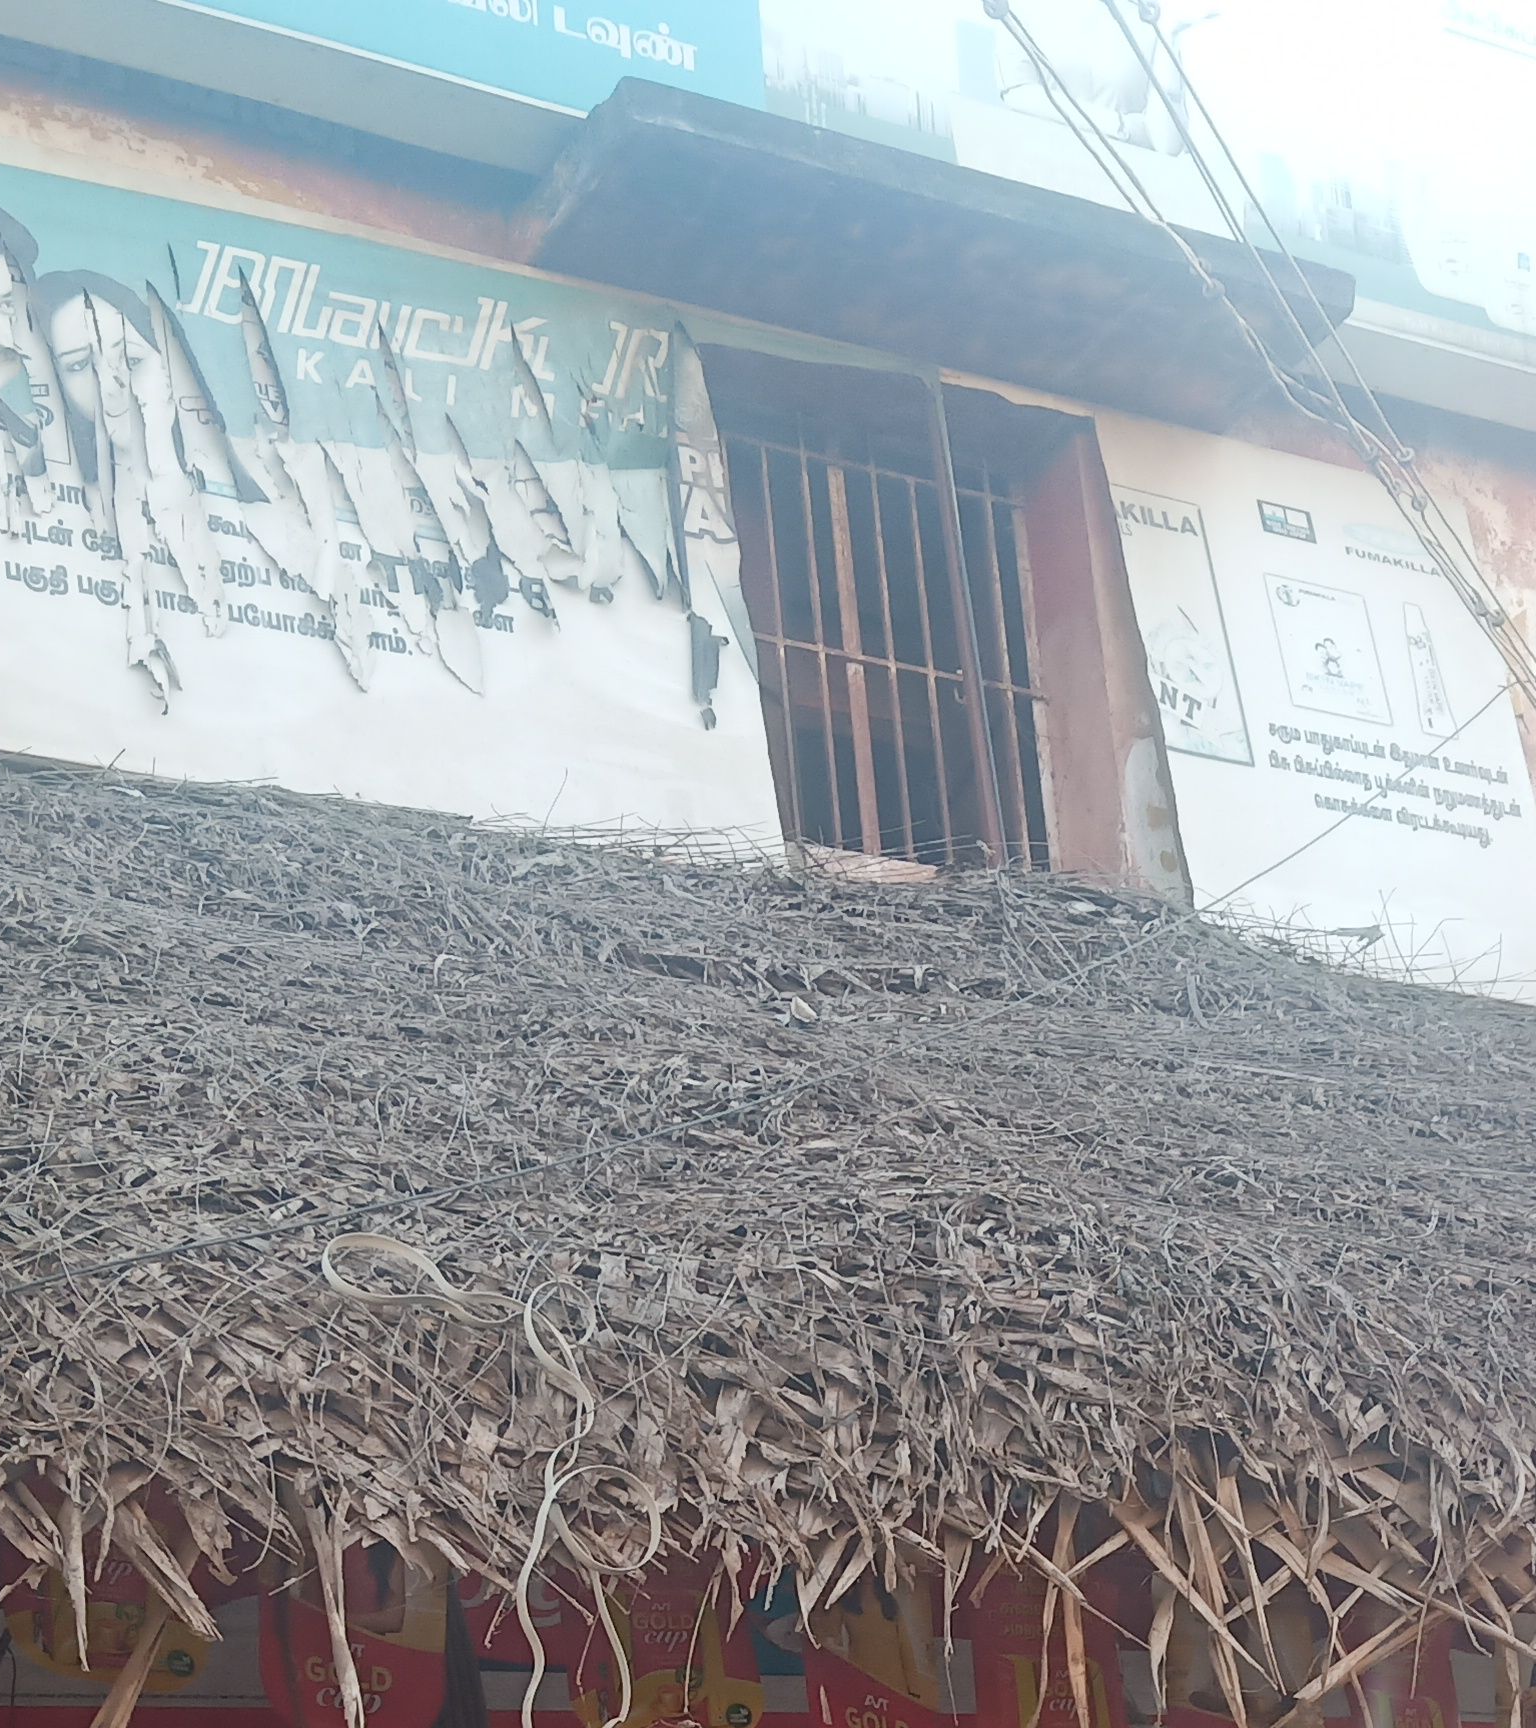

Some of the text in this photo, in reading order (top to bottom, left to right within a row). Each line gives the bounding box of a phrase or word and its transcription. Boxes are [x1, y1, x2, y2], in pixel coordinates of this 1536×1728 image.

[1344, 546, 1442, 578] FUMAKILLA
[5, 561, 69, 597] பகுதி
[1268, 723, 1301, 744] சரும
[632, 1612, 694, 1630] GOLD
[644, 1629, 689, 1653] cup
